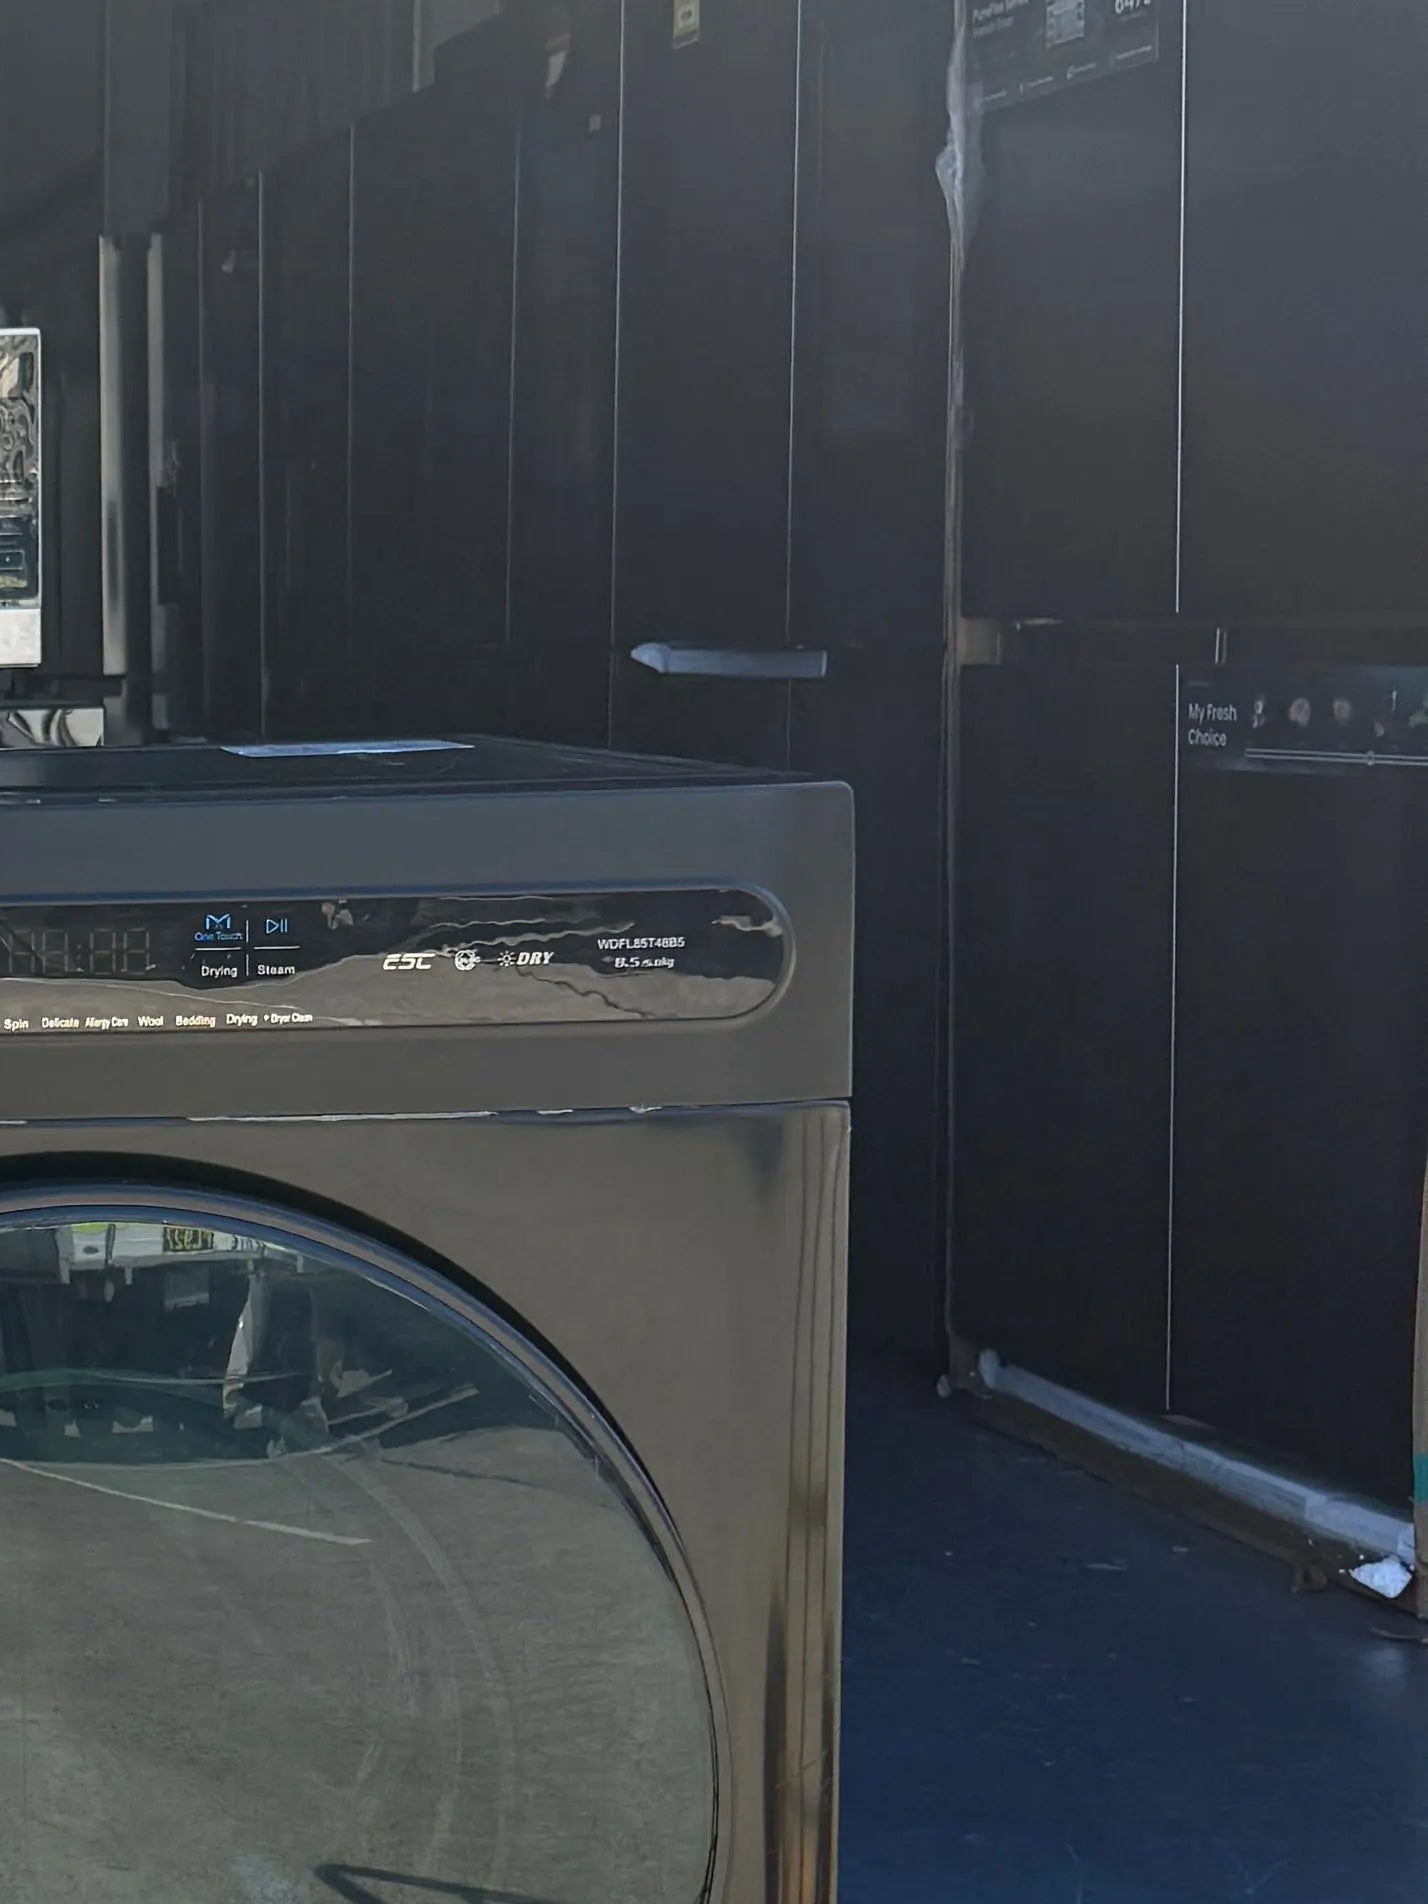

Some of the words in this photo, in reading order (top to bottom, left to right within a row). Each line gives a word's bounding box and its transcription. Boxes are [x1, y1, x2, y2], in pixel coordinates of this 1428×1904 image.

[1188, 729, 1227, 747] Choice
[194, 932, 214, 941] One
[216, 931, 243, 941] Touch
[516, 952, 554, 966] DRY
[201, 965, 238, 978] Drying
[257, 964, 295, 975] Steam
[4, 1018, 29, 1031] Spin
[42, 1018, 80, 1028] Delicate
[138, 1016, 163, 1026] Wool
[176, 1015, 216, 1027] Bedding
[226, 1014, 257, 1026] Drying
